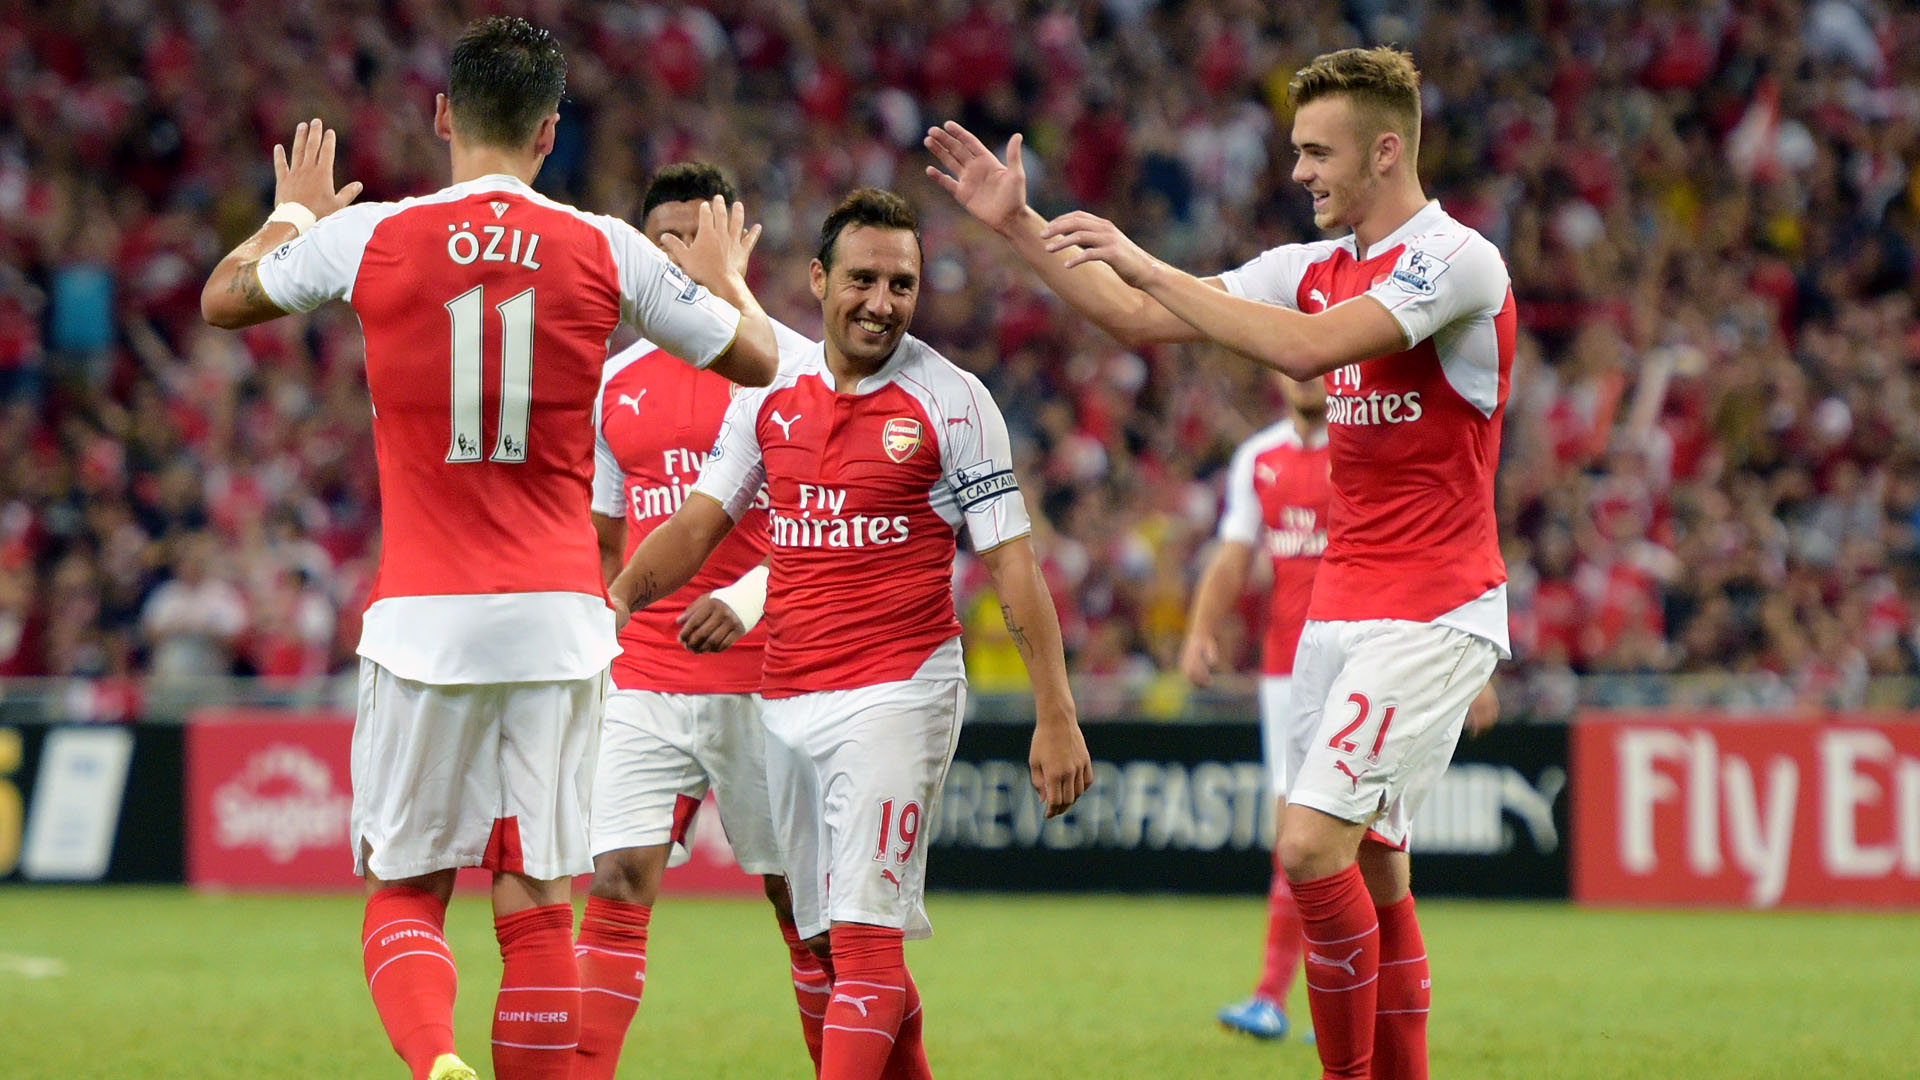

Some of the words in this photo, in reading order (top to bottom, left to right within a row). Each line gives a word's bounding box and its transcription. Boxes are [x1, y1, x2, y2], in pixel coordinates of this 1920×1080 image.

[447, 220, 541, 271] ÖZIL
[443, 284, 535, 463] 11
[889, 424, 918, 434] Arsenal
[799, 484, 846, 515] Fly
[1327, 691, 1398, 765] 21
[873, 797, 920, 865] 19
[1618, 728, 1800, 908] Fly
[498, 1011, 569, 1023] GUNNERS
